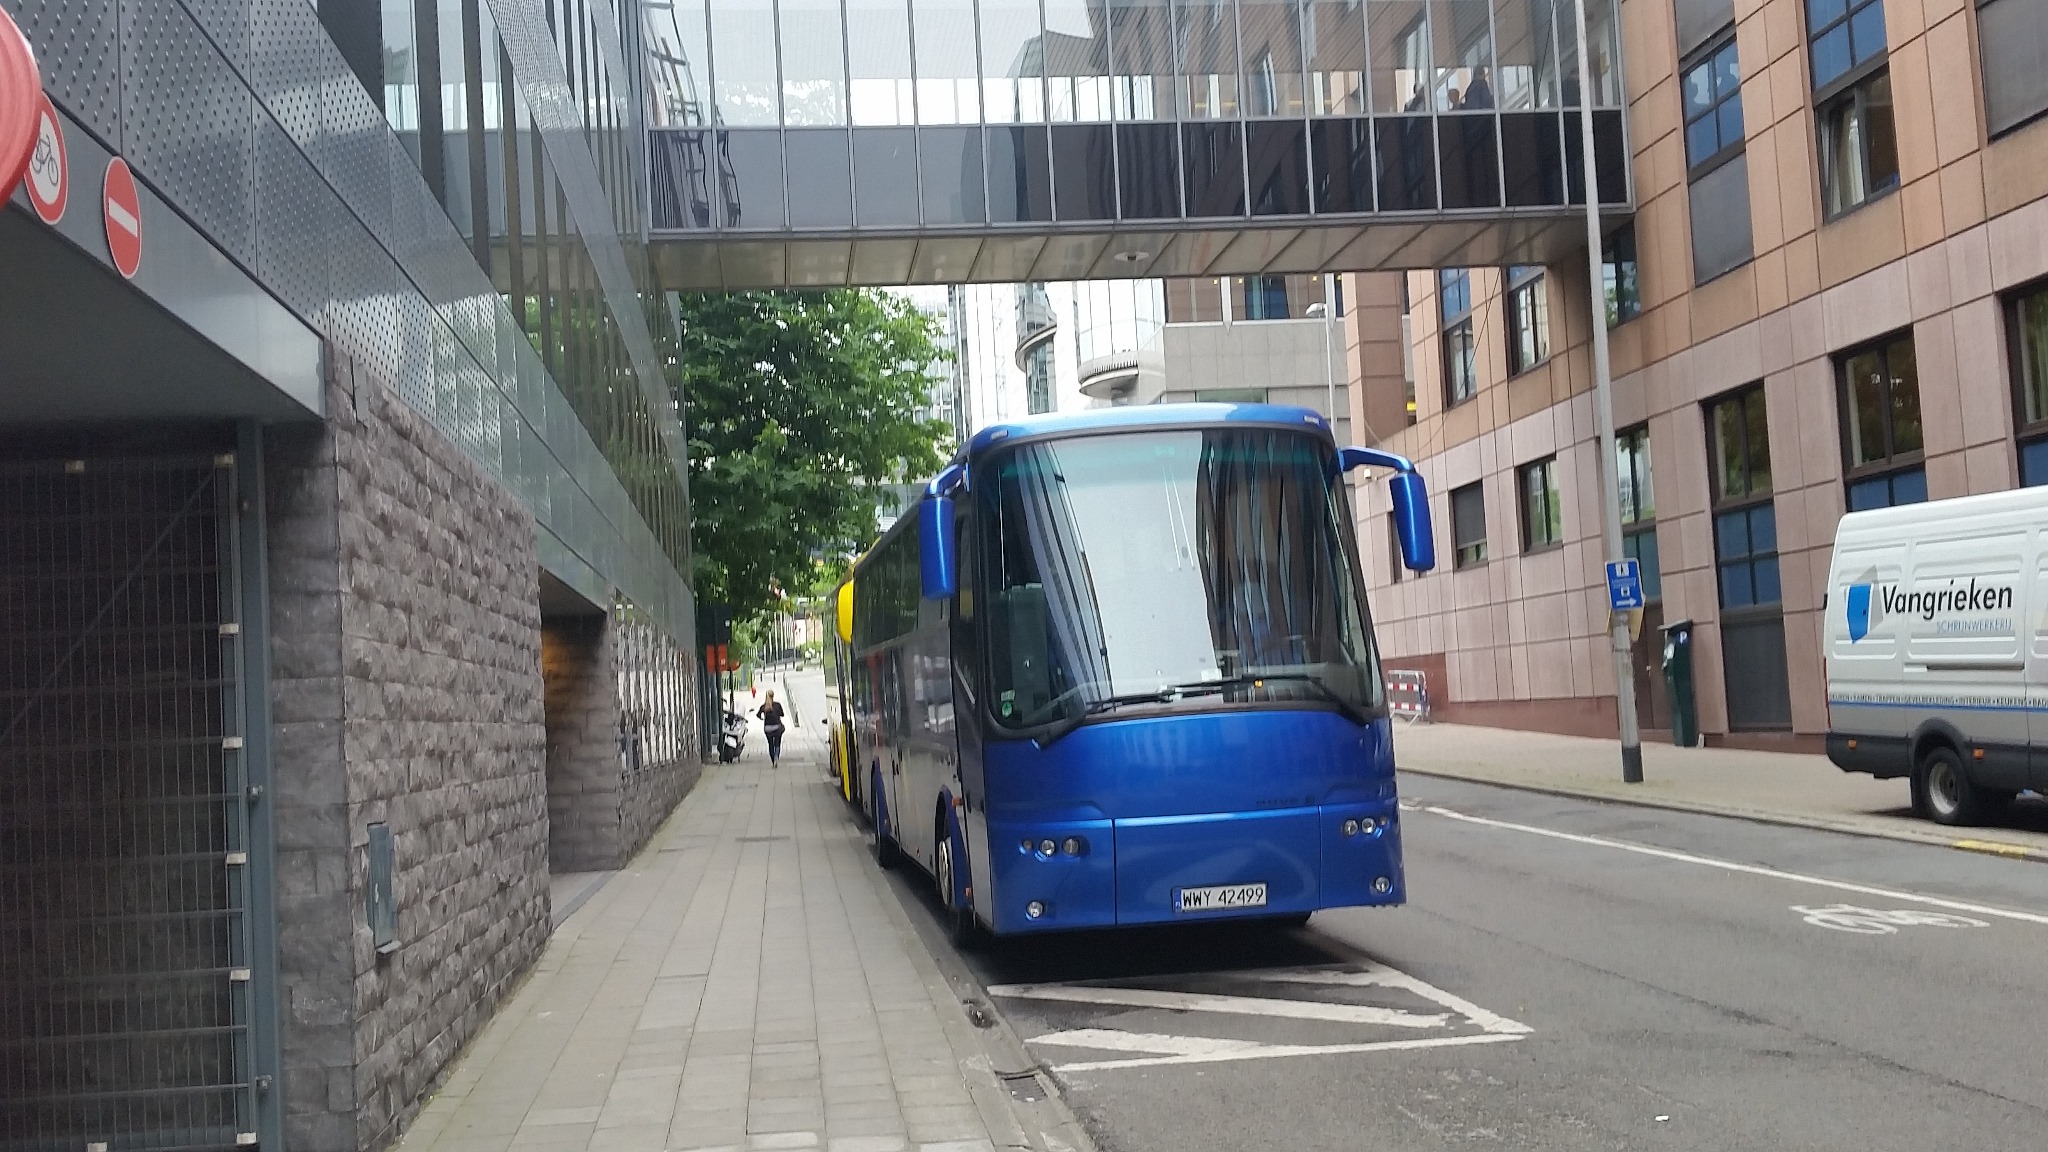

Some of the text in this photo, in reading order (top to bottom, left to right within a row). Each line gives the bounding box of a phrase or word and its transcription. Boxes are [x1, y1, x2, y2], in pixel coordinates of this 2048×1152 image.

[1882, 578, 2013, 620] Vangrieken
[1183, 887, 1264, 907] WWY 42499
